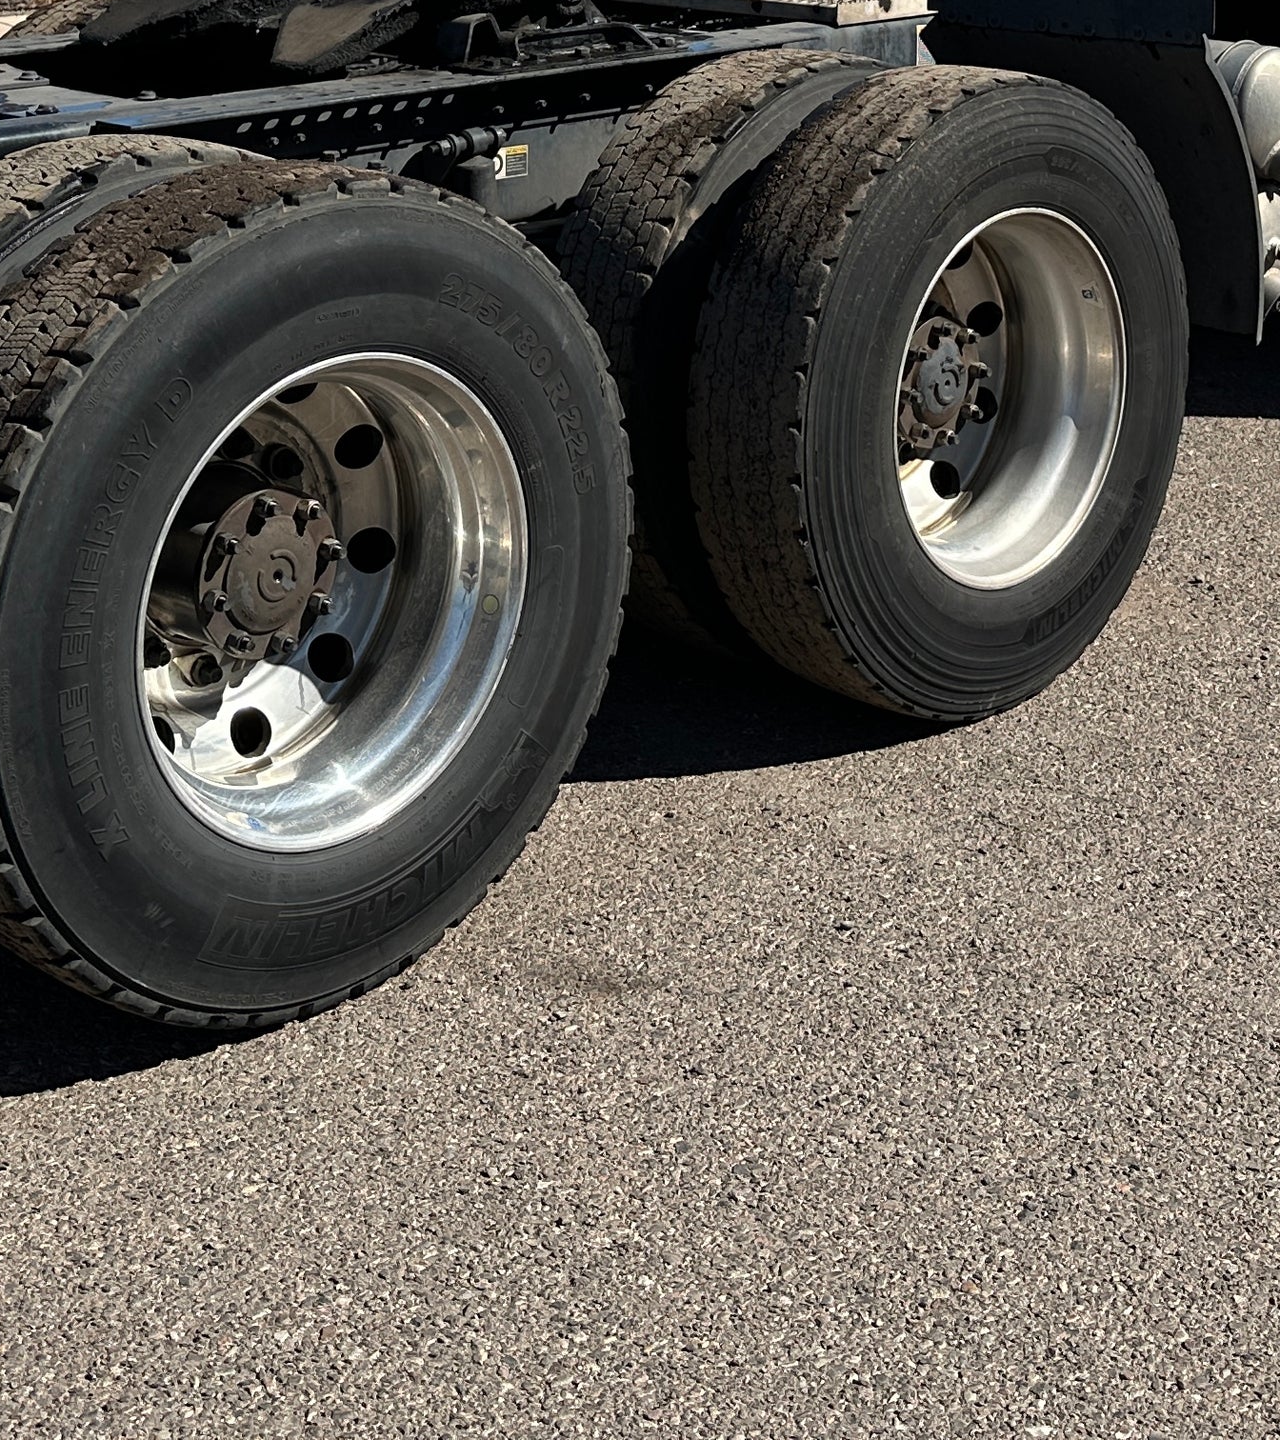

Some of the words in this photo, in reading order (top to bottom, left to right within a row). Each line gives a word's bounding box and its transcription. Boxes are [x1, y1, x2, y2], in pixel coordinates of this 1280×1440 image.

[154, 375, 194, 423] D
[57, 419, 158, 670] ENERGY
[57, 683, 110, 815] LINE
[213, 817, 478, 960] MICHELIN
